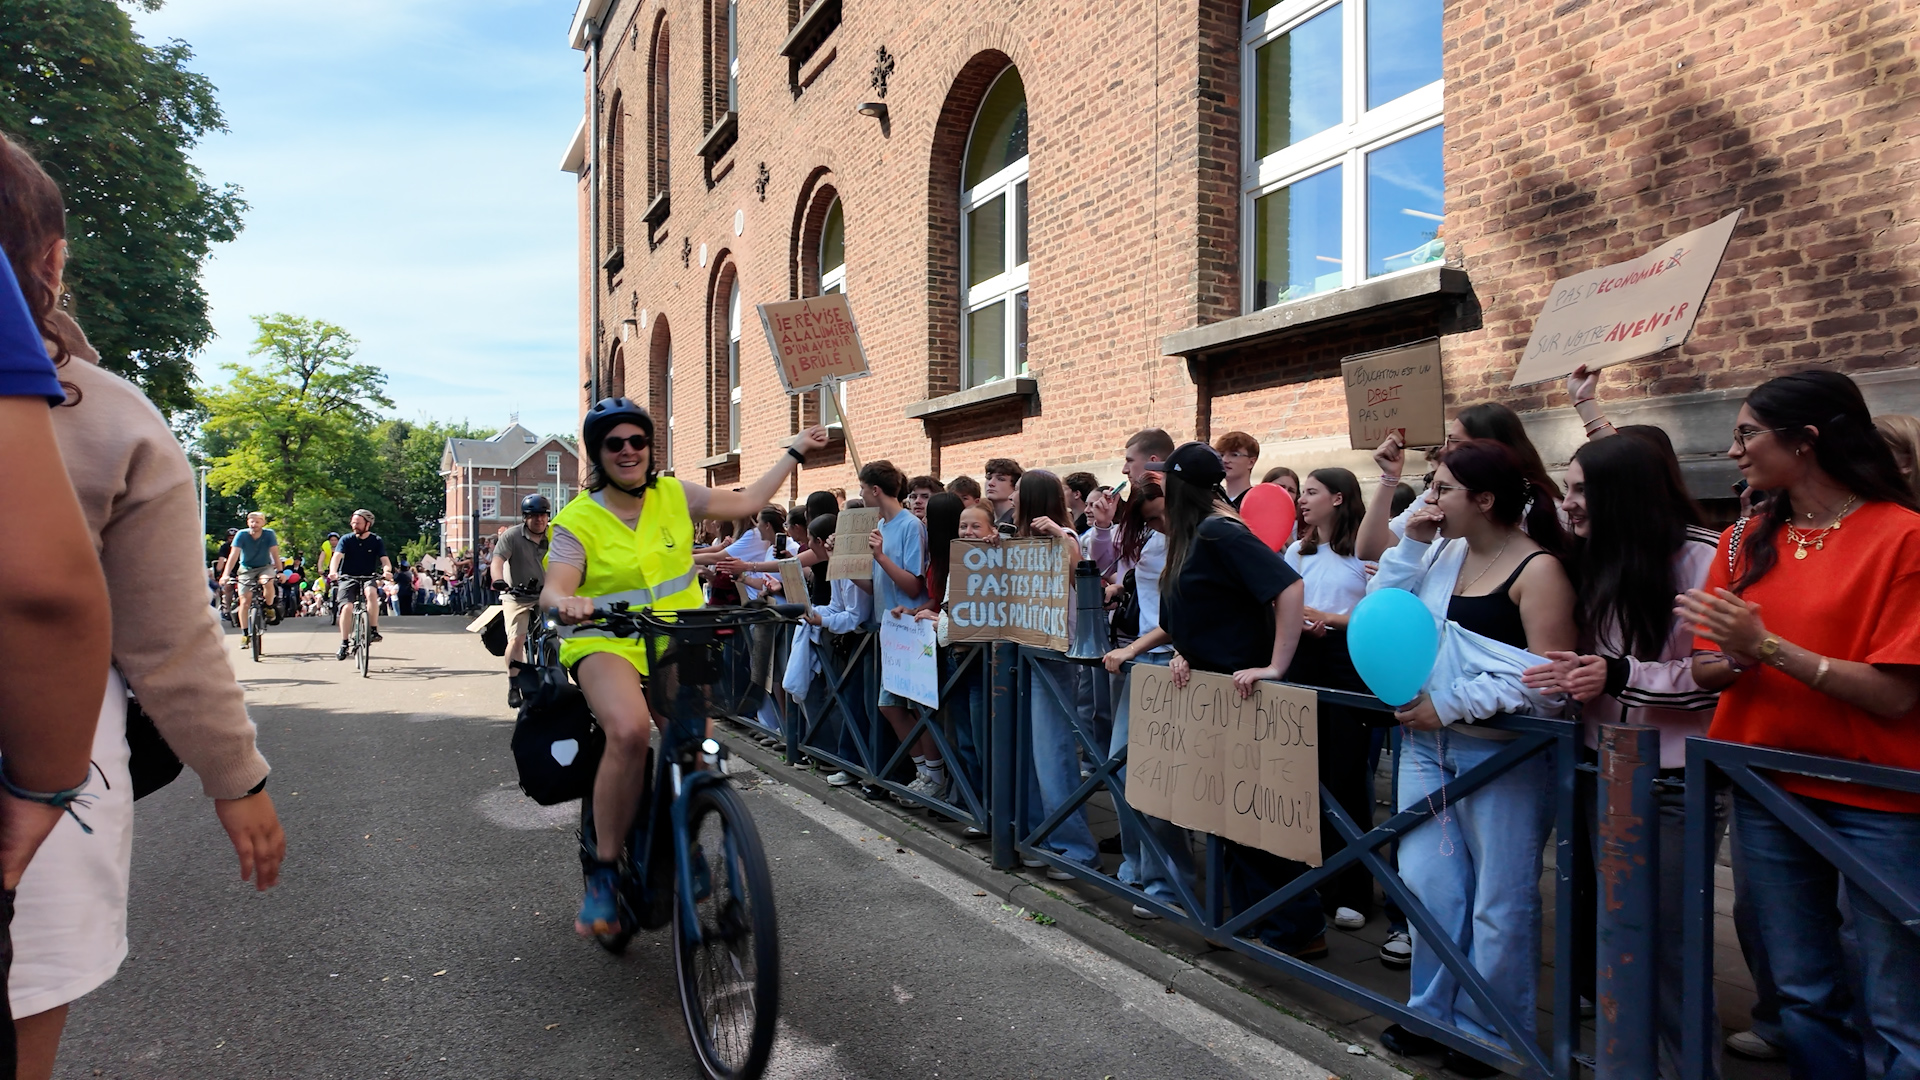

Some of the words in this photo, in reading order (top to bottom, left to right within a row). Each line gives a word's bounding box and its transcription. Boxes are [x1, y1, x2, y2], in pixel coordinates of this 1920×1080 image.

[1555, 284, 1581, 306] PAS
[1530, 332, 1561, 359] SUR
[1564, 324, 1611, 349] NOTRE
[1604, 302, 1689, 342] AVENIR
[784, 343, 810, 356] D'UN
[1401, 366, 1416, 376] EST
[1419, 365, 1431, 375] UN
[1367, 385, 1403, 404] DROIT
[1359, 408, 1379, 422] PAS
[1384, 408, 1398, 418] UN
[963, 547, 1003, 571] ON
[1006, 545, 1026, 571] EST
[967, 573, 1009, 596] PAS
[1010, 574, 1030, 597] TES
[950, 601, 1007, 627] CULS
[1193, 728, 1223, 759] ET
[1232, 743, 1261, 770] ON
[1268, 758, 1294, 783] TE
[1193, 767, 1225, 806] UN
